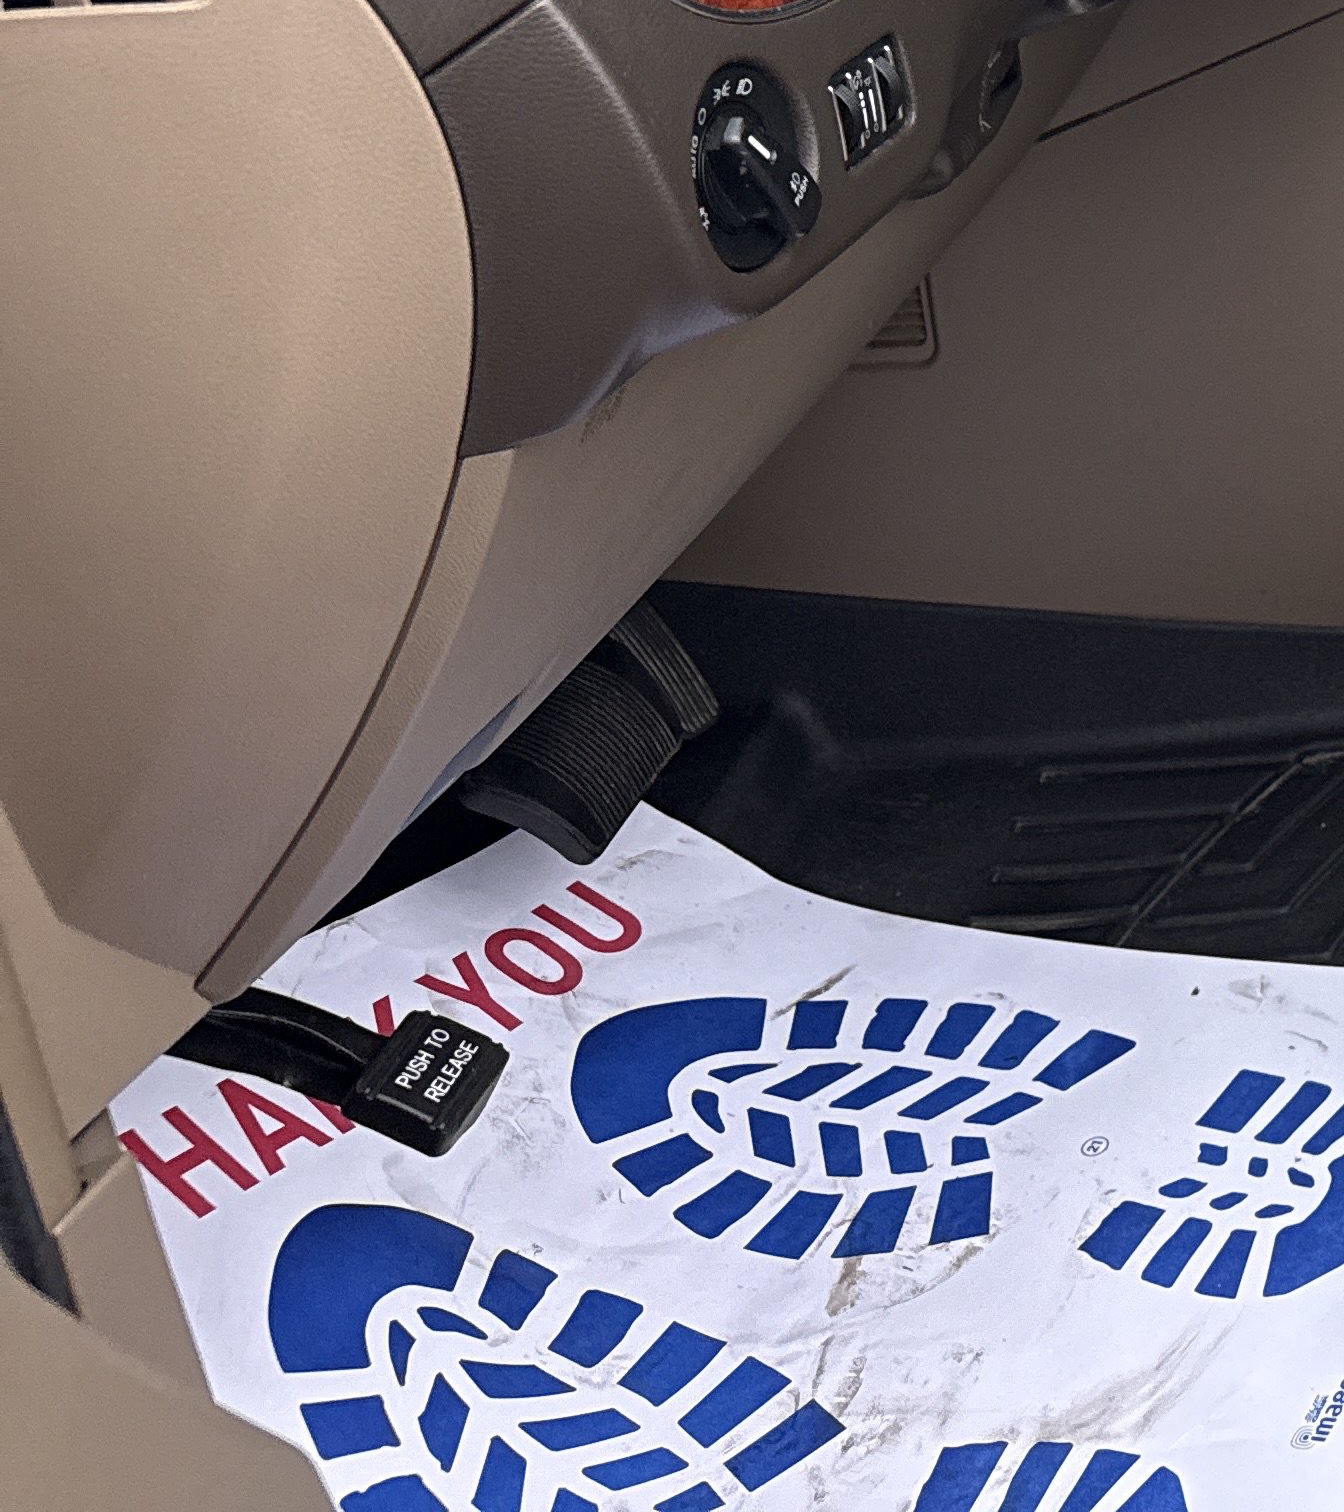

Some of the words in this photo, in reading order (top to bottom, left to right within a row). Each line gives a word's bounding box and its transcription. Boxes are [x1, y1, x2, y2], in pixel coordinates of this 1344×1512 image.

[414, 880, 643, 1033] YOU
[394, 1049, 435, 1090] PUSH
[424, 1028, 450, 1049] TO
[423, 1039, 480, 1103] RELEASE
